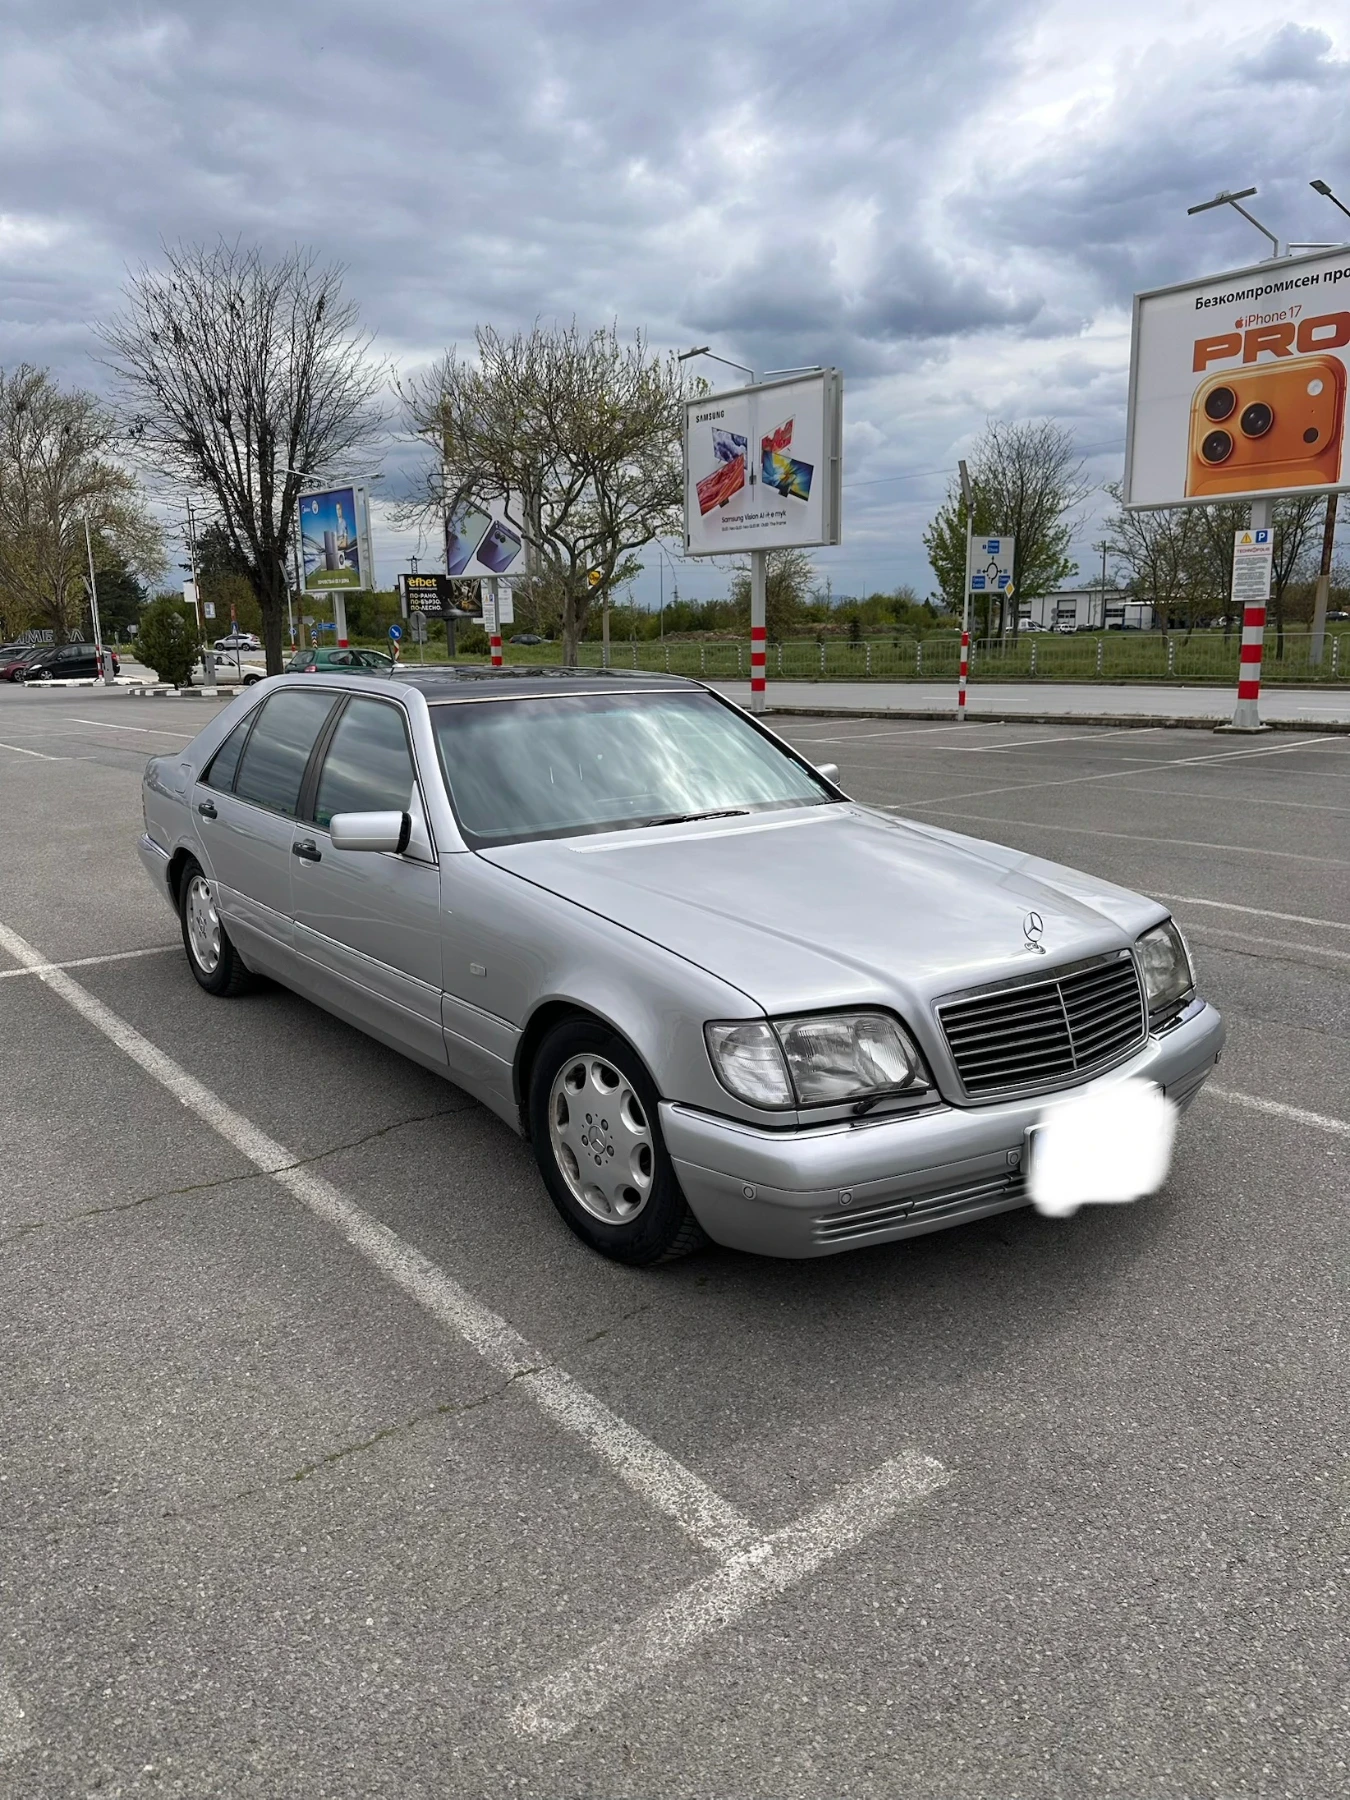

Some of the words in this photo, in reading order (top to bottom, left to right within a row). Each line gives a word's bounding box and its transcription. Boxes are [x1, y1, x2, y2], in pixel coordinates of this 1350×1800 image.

[1195, 273, 1320, 310] Безкомпромисен
[1244, 309, 1287, 328] iPhone
[1288, 304, 1303, 319] 17
[1192, 311, 1350, 373] PRO
[695, 410, 725, 423] SAMSUNG
[721, 515, 744, 523] Samsung
[408, 577, 437, 587] efbet
